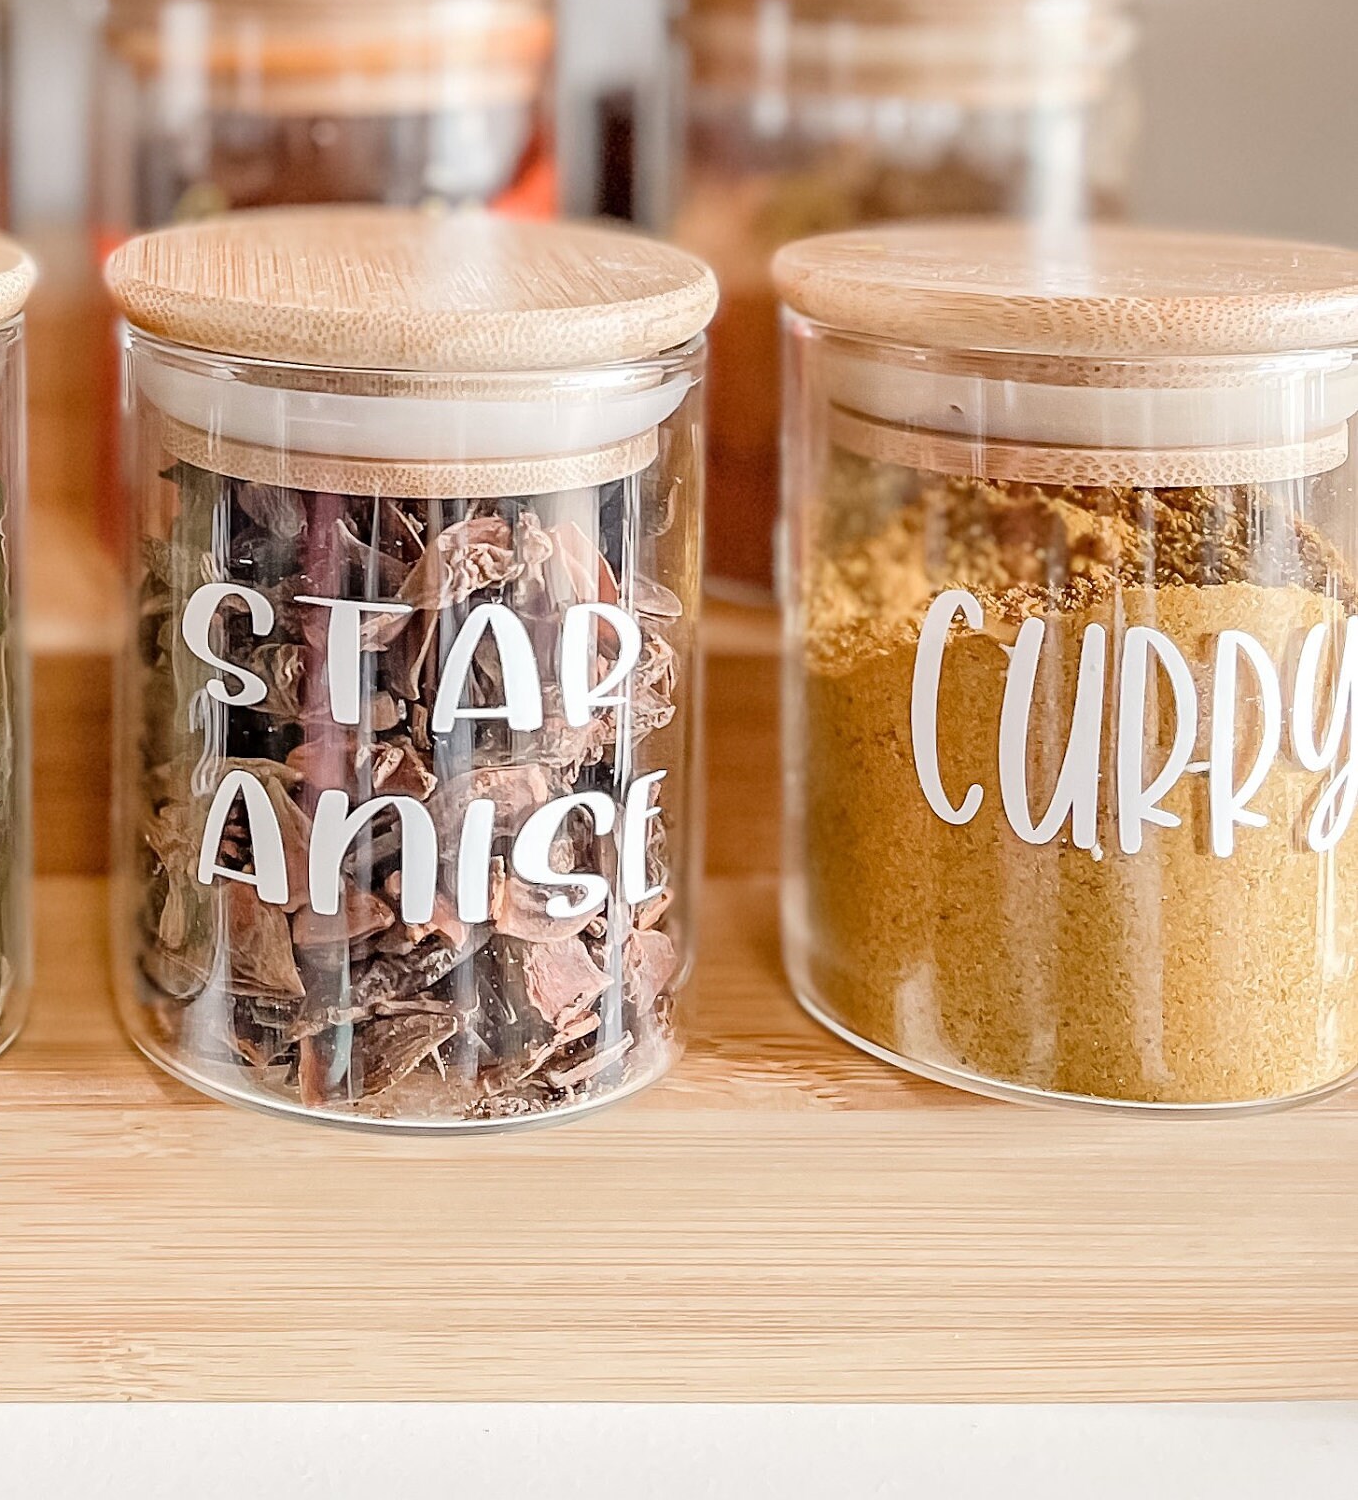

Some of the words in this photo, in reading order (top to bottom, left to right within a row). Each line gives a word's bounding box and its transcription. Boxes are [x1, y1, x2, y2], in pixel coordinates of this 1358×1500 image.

[181, 582, 642, 733] STAR
[910, 589, 1358, 858] CURRY
[197, 768, 668, 925] ANISE
